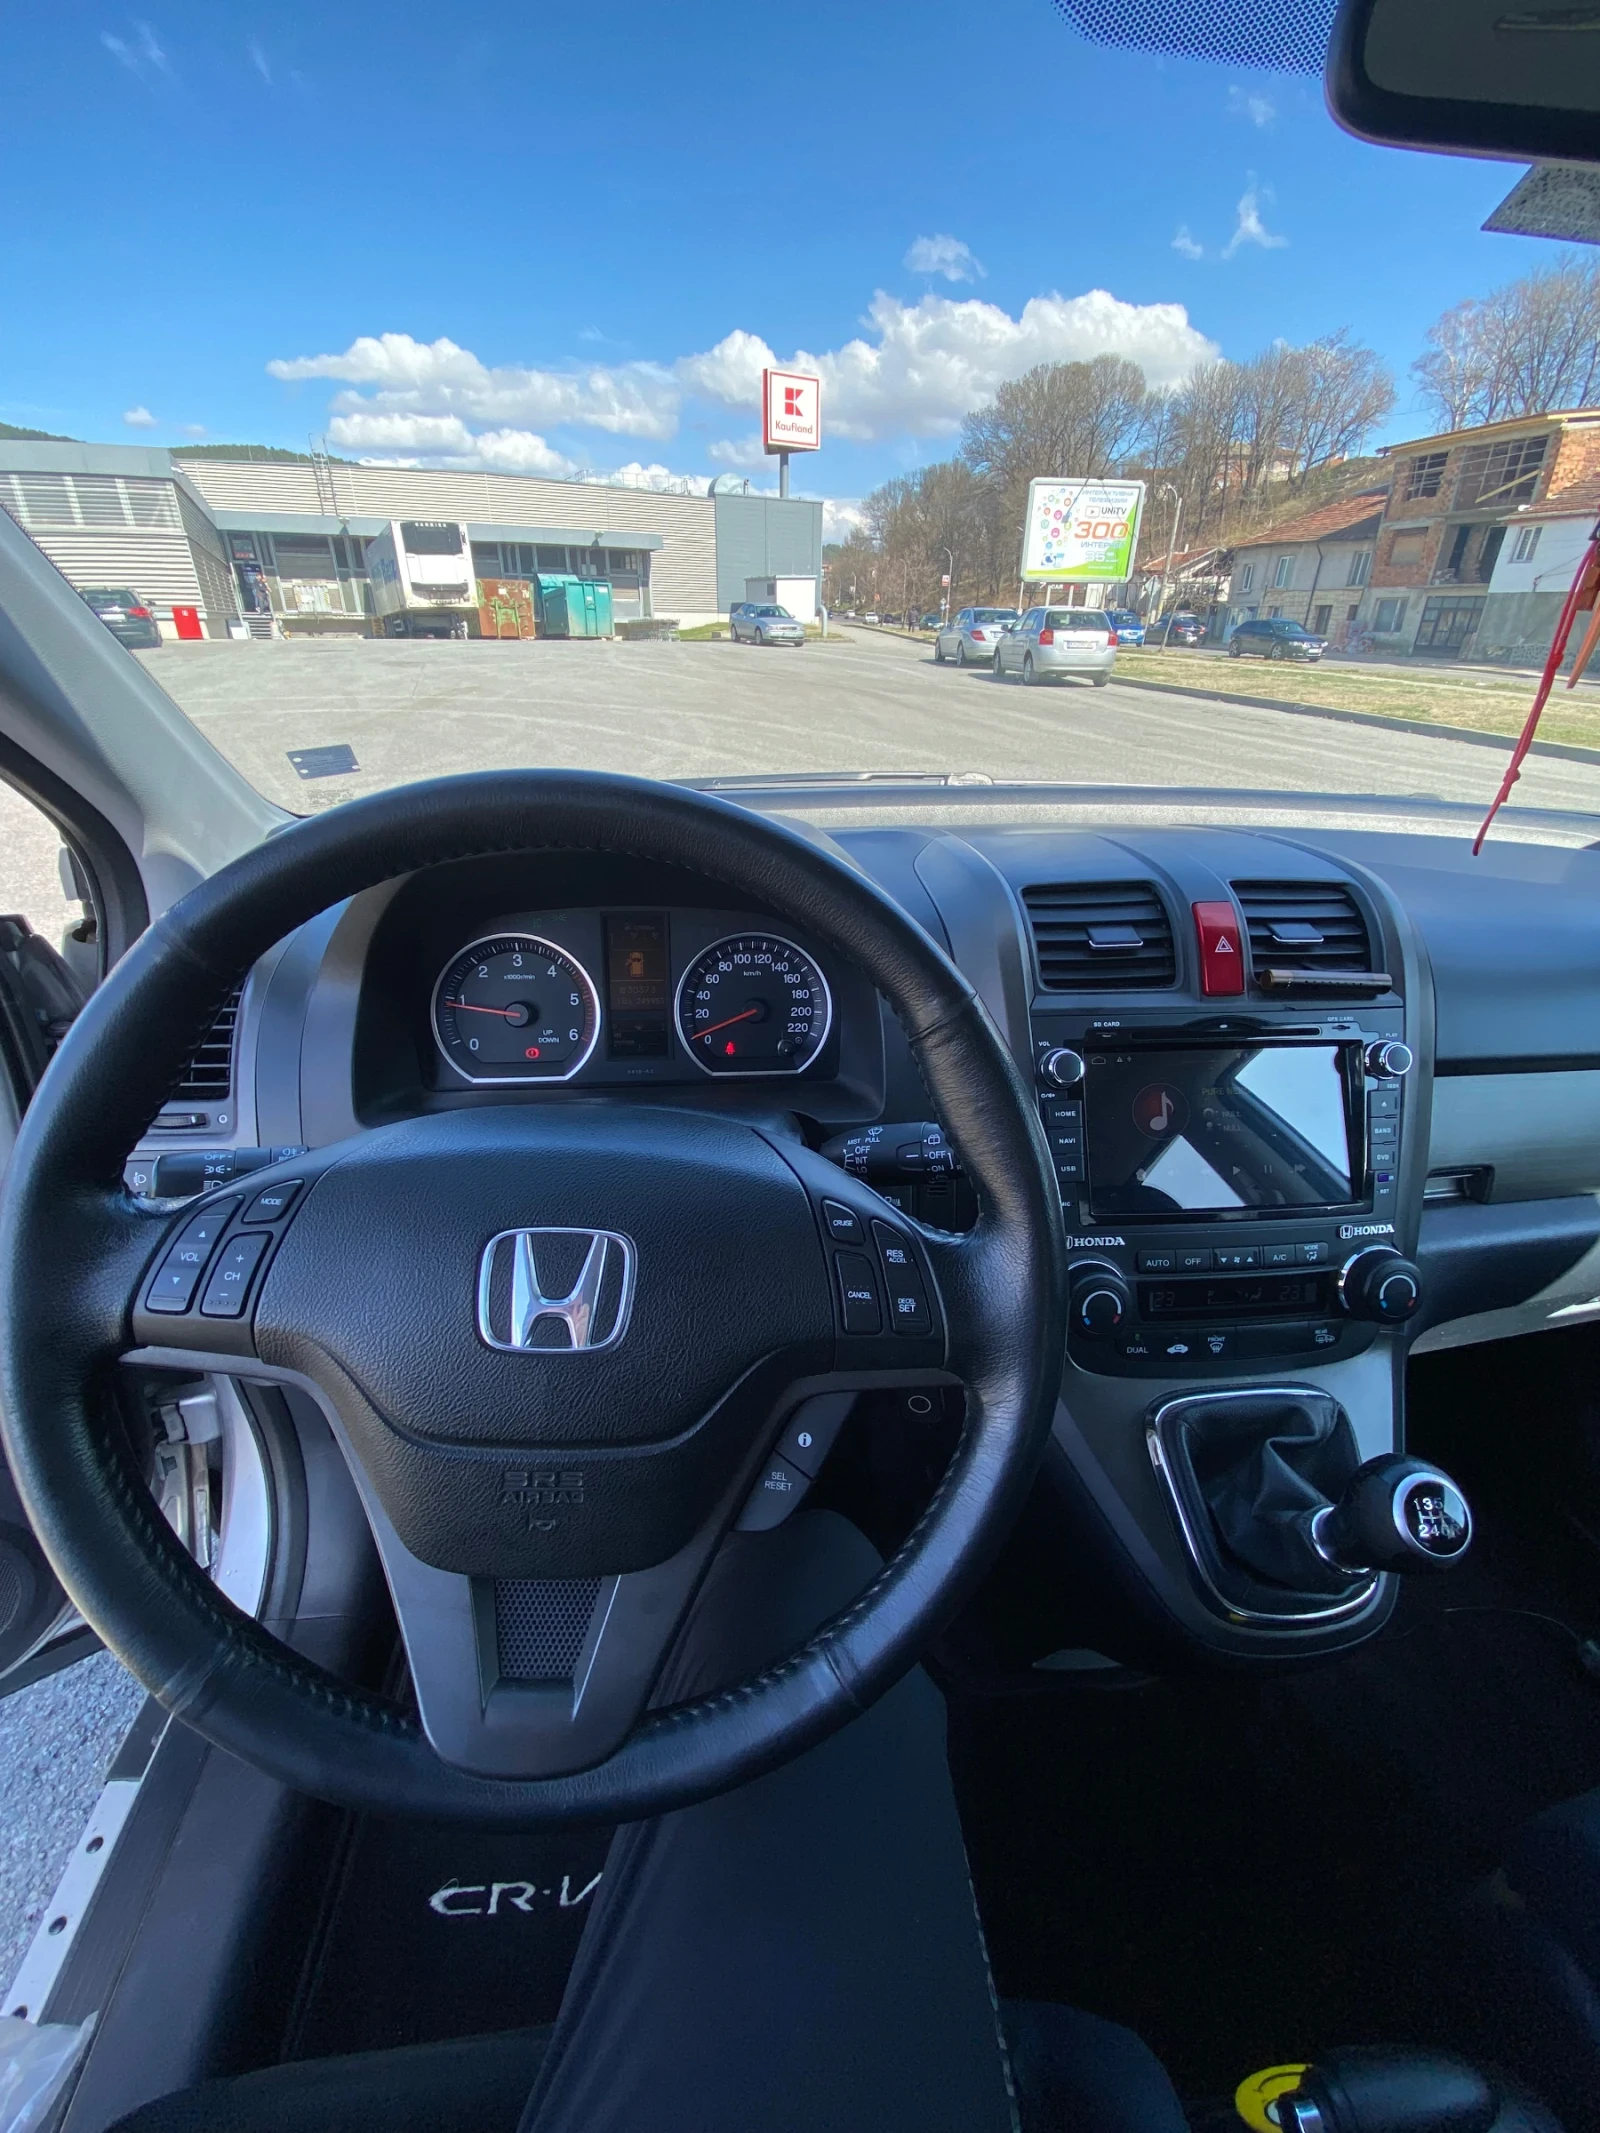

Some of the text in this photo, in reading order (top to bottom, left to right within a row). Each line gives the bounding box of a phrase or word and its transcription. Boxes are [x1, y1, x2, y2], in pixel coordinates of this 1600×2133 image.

[776, 420, 813, 434] Kaufland
[1074, 521, 1129, 539] 300
[512, 954, 523, 967] 3
[733, 954, 751, 964] 100
[754, 954, 772, 964] 120
[478, 965, 488, 978] 2
[547, 965, 557, 977] 4
[719, 962, 733, 972] 80
[771, 962, 789, 972] 140
[705, 974, 720, 984] 60
[784, 974, 801, 983] 160
[570, 993, 579, 1005] 5
[696, 991, 710, 1000] 40
[792, 989, 810, 999] 180
[460, 995, 465, 1006] 1
[695, 1009, 709, 1019] 20
[790, 1007, 812, 1016] 200
[787, 1023, 809, 1033] 220
[569, 1029, 579, 1041] 6
[704, 1035, 712, 1044] 0
[470, 1038, 479, 1050] 0
[1058, 1137, 1076, 1145] NAVI
[855, 1146, 871, 1154] OFF
[929, 1150, 946, 1160] OFF
[855, 1156, 868, 1165] INT
[857, 1166, 868, 1174] LO
[931, 1164, 945, 1172] ON
[260, 1198, 283, 1206] MODE
[832, 1219, 854, 1227] CRUISE
[1353, 1224, 1395, 1236] HONDA
[1073, 1236, 1126, 1247] HONDA
[180, 1252, 200, 1262] VOL
[886, 1249, 904, 1258] RES
[1272, 1253, 1287, 1262] A/C
[1146, 1259, 1170, 1268] AUTO
[1184, 1258, 1202, 1266] OFF
[224, 1272, 241, 1281] CH
[847, 1290, 872, 1300] CANCEL
[898, 1304, 916, 1313] SET
[1126, 1346, 1148, 1354] DUAL
[503, 1471, 584, 1487] SRS
[771, 1471, 787, 1481] SEL
[764, 1480, 793, 1492] RESET
[502, 1490, 584, 1504] AIRBAG
[1422, 1498, 1434, 1511] 3
[1418, 1524, 1431, 1538] 2
[1430, 1524, 1440, 1537] 4
[428, 1872, 604, 1915] CR-V
